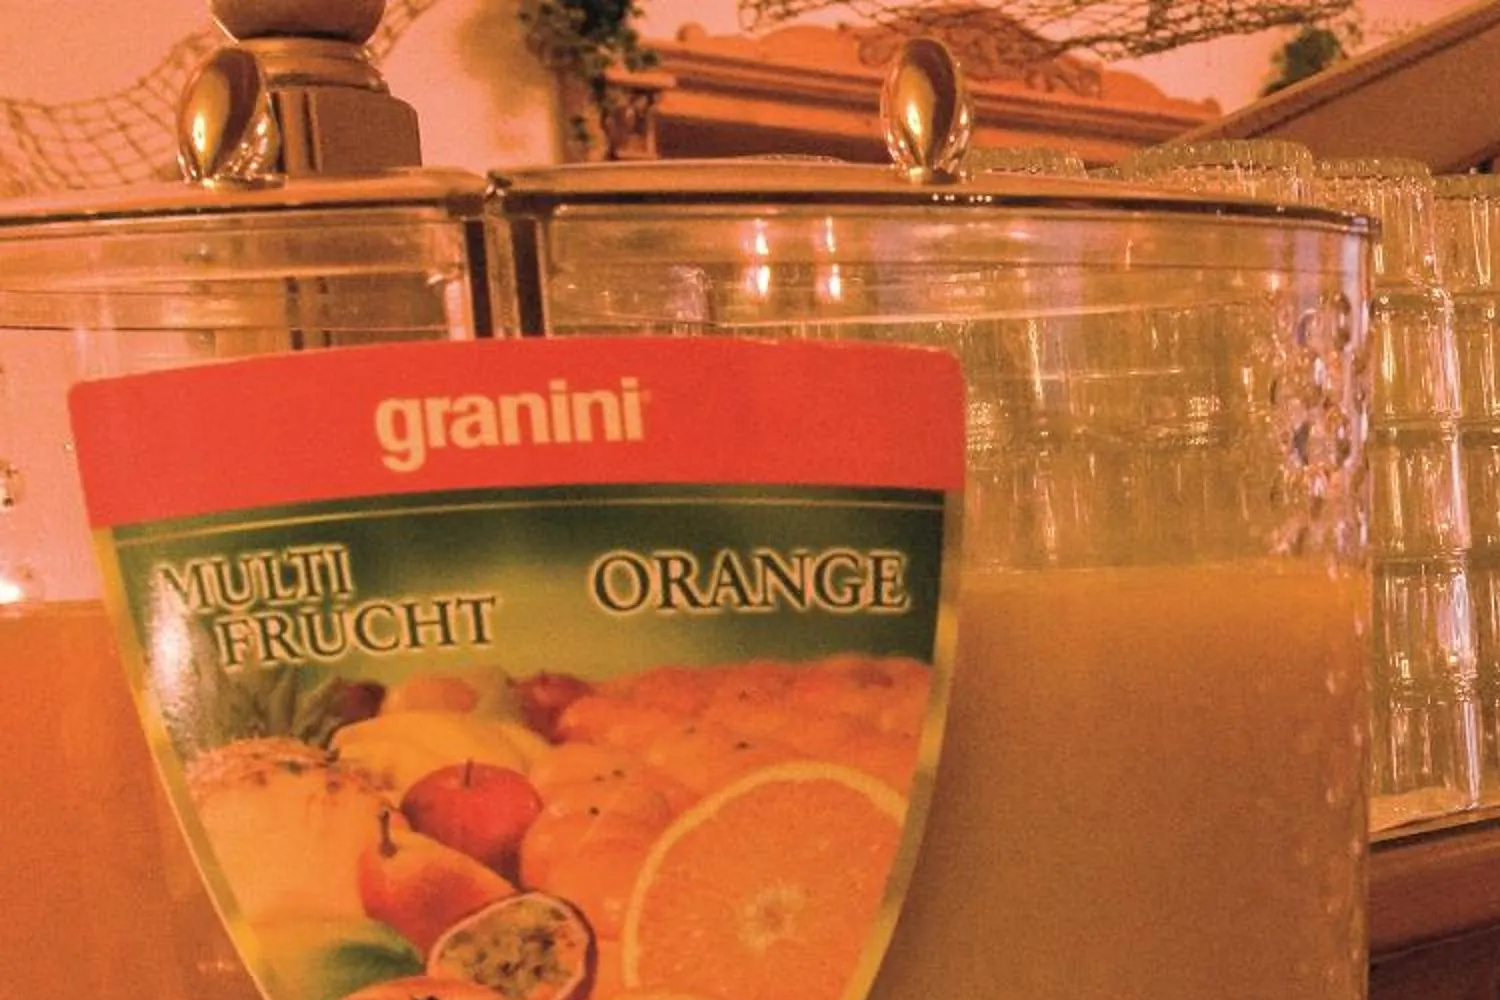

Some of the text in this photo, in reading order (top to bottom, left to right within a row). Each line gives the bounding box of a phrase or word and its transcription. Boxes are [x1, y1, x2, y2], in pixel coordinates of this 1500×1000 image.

[375, 376, 645, 472] granini
[158, 545, 352, 614] MULTI
[592, 549, 908, 615] ORANGE
[215, 593, 498, 669] FRUCHT
